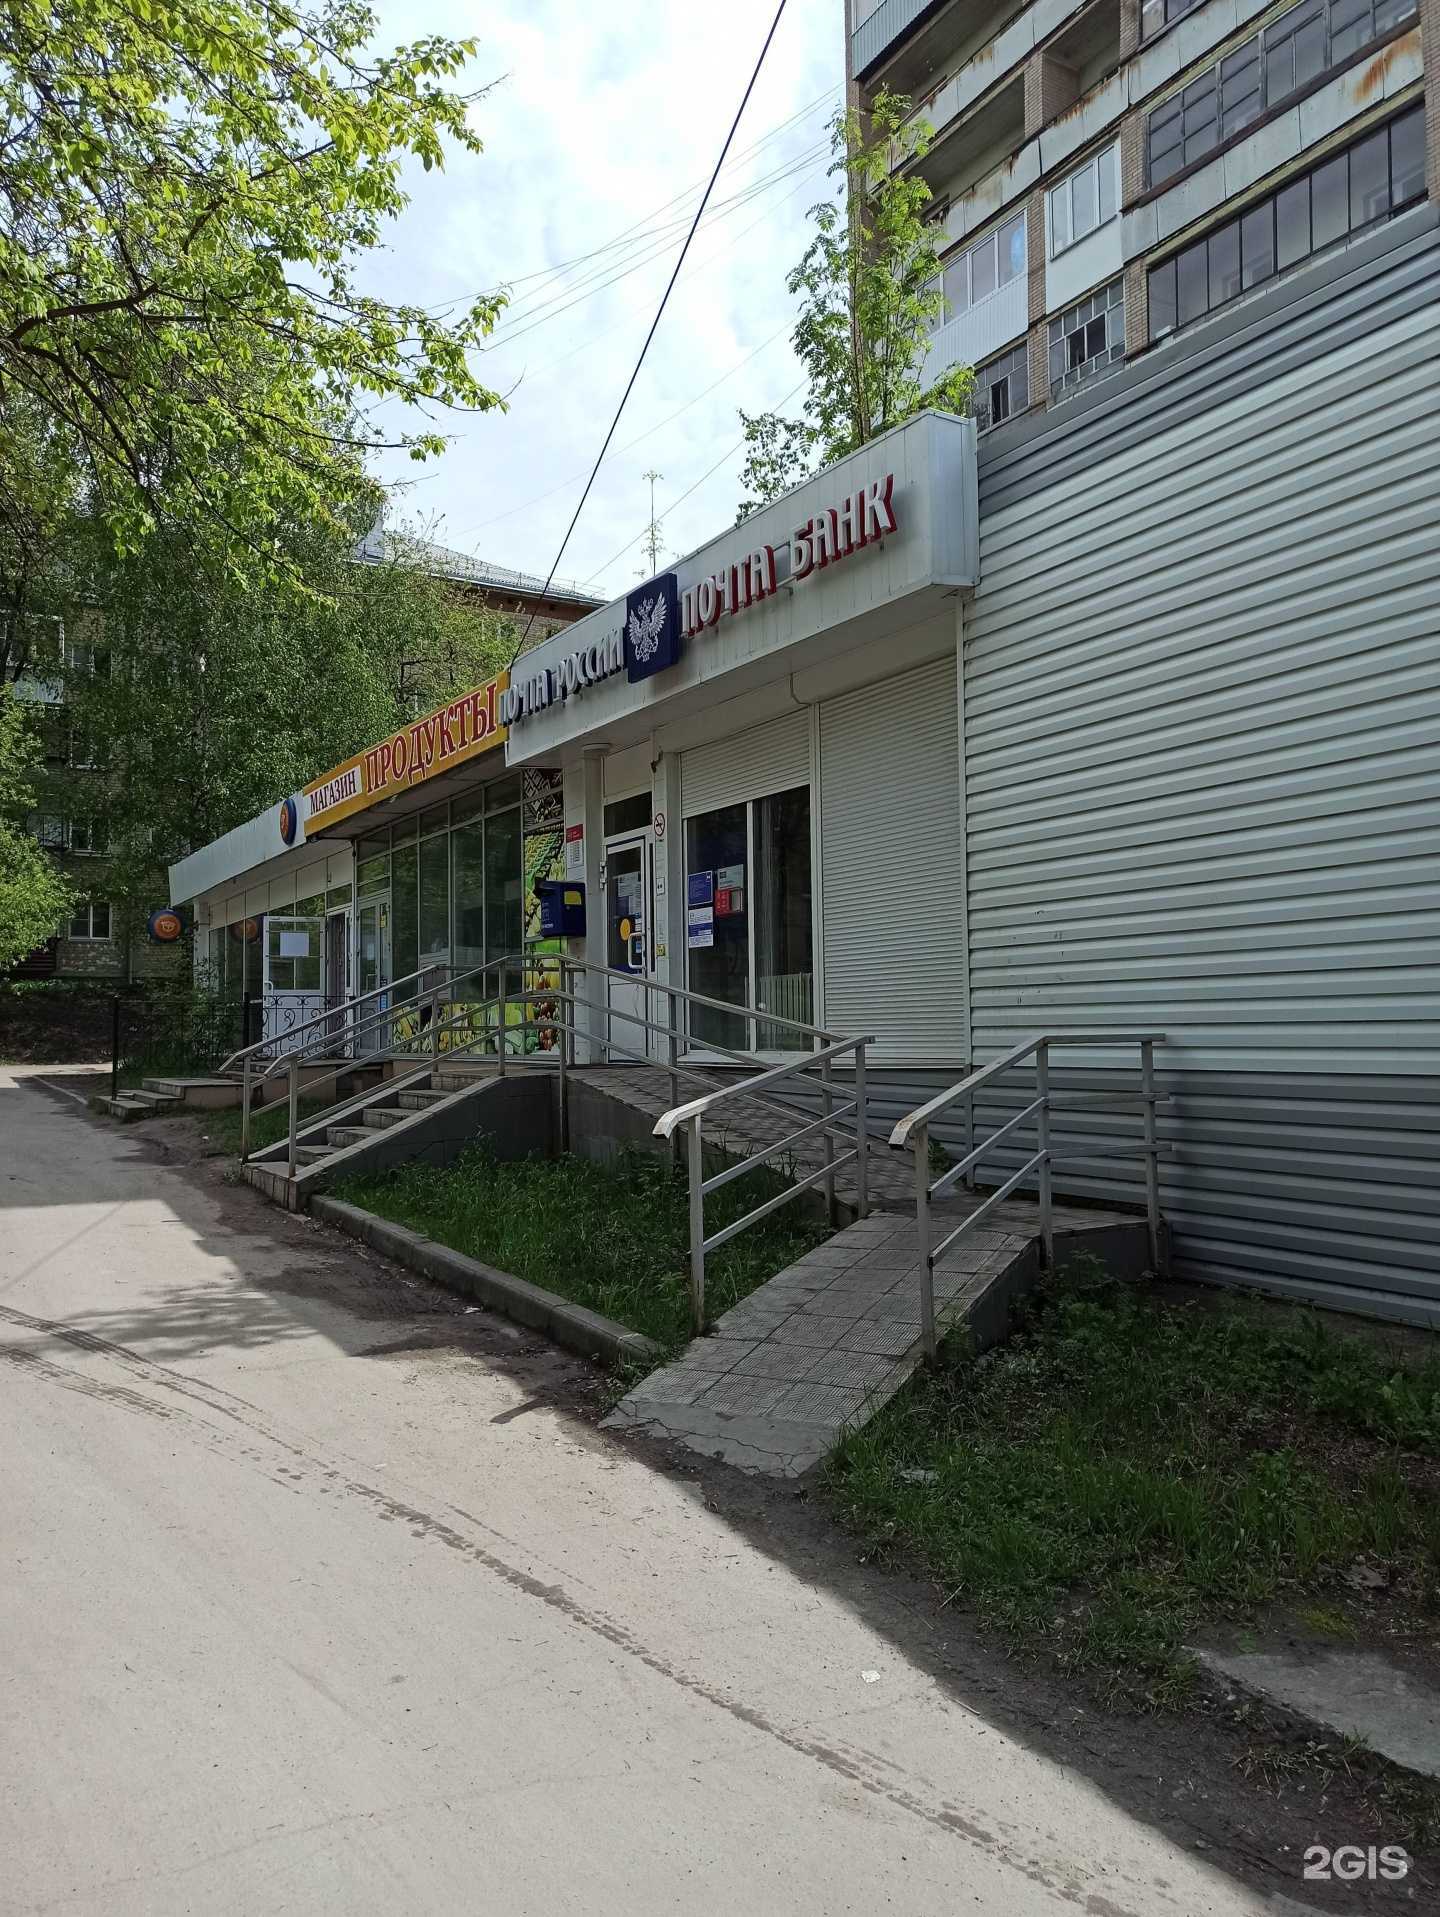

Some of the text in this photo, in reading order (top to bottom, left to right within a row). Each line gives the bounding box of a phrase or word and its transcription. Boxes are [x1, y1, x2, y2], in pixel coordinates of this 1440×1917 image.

[681, 473, 898, 638] ПОЧТА БАНК
[499, 627, 627, 728] ПОЧТА РОССИИ
[309, 681, 498, 816] МАГАЗИН ПРОДУКТЫ
